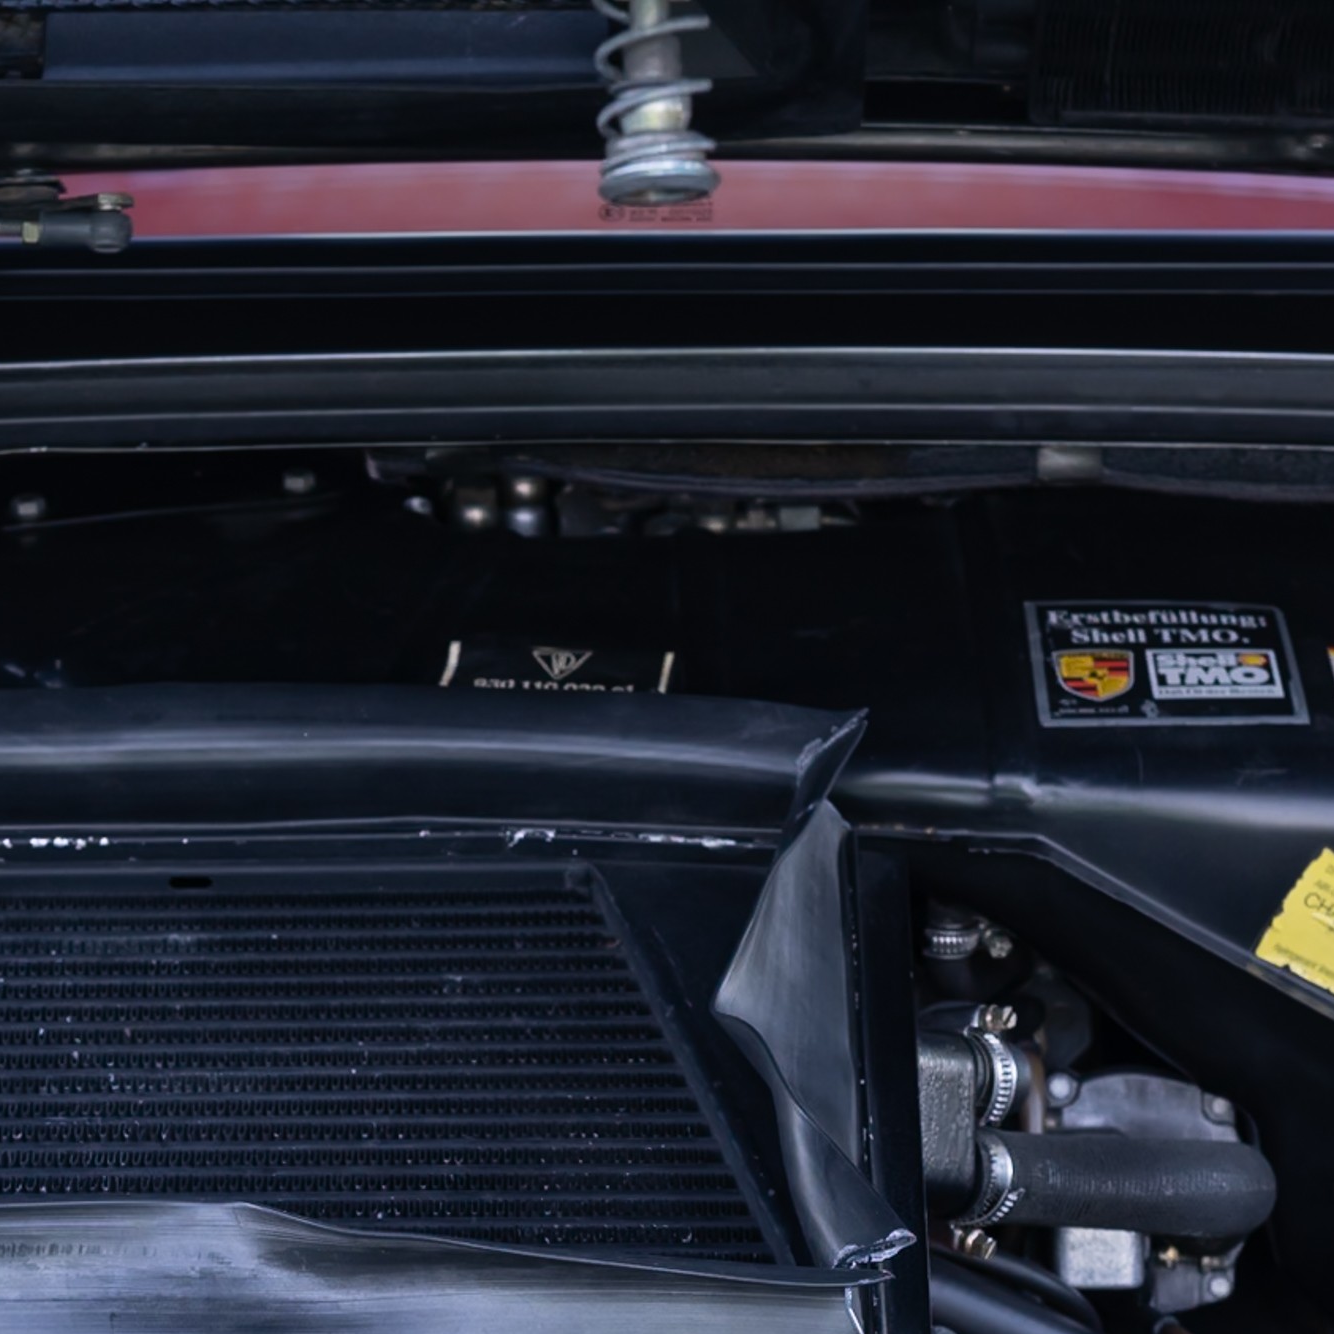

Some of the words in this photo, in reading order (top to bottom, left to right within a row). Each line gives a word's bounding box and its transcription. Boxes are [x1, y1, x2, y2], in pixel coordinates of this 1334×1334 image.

[1047, 609, 1267, 629] Erstbefüllung:
[1071, 628, 1147, 644] Shell
[1156, 654, 1237, 667] Shell
[1158, 667, 1269, 685] TMO
